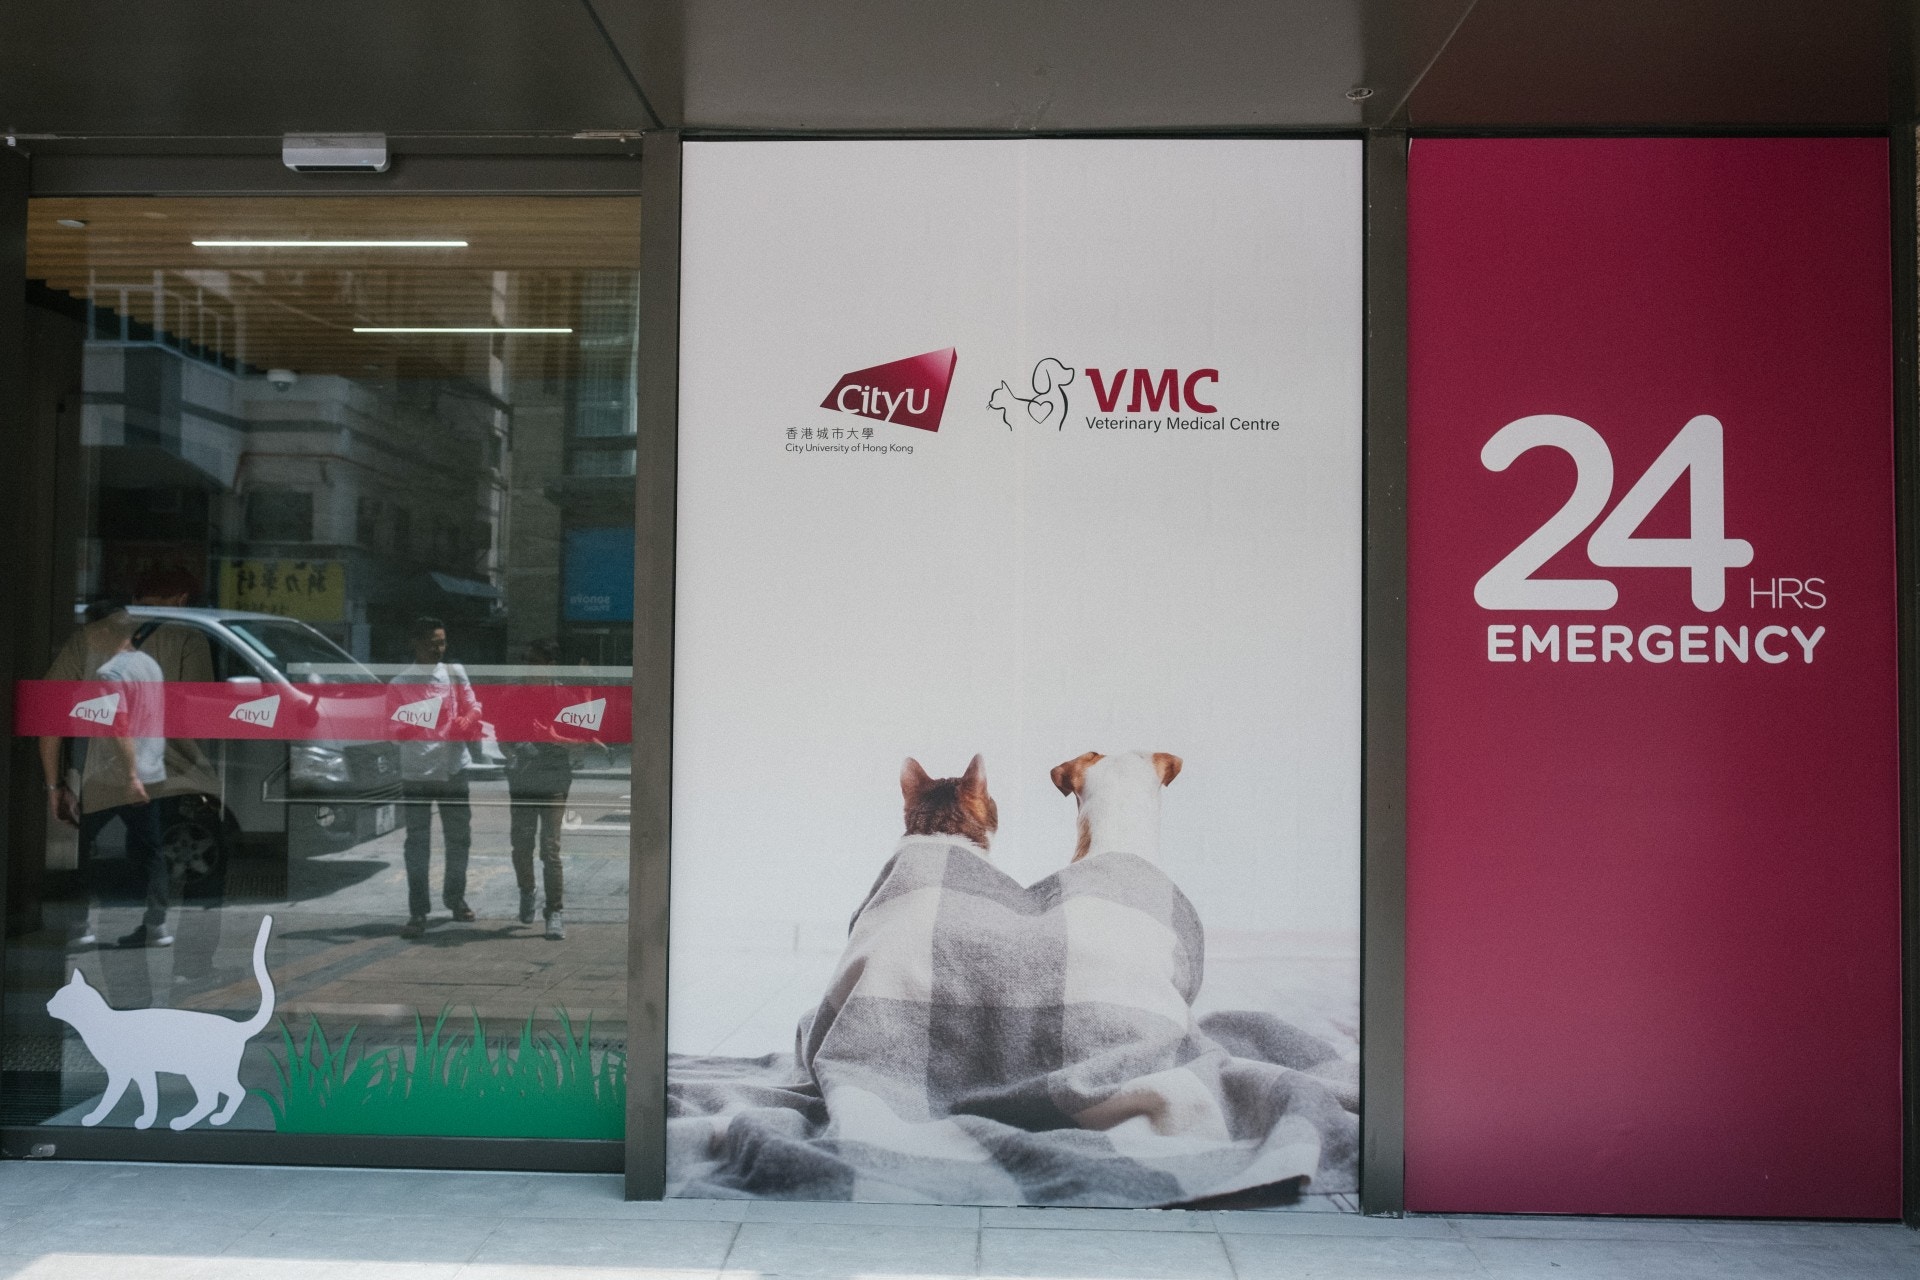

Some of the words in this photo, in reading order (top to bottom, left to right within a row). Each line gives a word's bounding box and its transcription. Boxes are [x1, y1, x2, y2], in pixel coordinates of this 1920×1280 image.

[1085, 368, 1219, 414] VMC
[837, 384, 930, 423] CityU
[1085, 416, 1162, 433] Veterinary
[1167, 416, 1225, 431] Medical
[1230, 417, 1280, 431] Centre
[785, 427, 875, 440] 香港城市大學
[785, 443, 803, 454] City
[805, 443, 849, 454] University
[851, 443, 861, 452] of
[862, 443, 888, 455] Hong
[889, 443, 914, 455] Kong
[1473, 414, 1755, 613] 24
[1750, 577, 1827, 609] HRS
[1487, 624, 1826, 664] EMERGENCY
[75, 706, 109, 722] CityU
[235, 708, 270, 723] CityU
[397, 710, 433, 726] CityU
[560, 712, 596, 727] CityU
